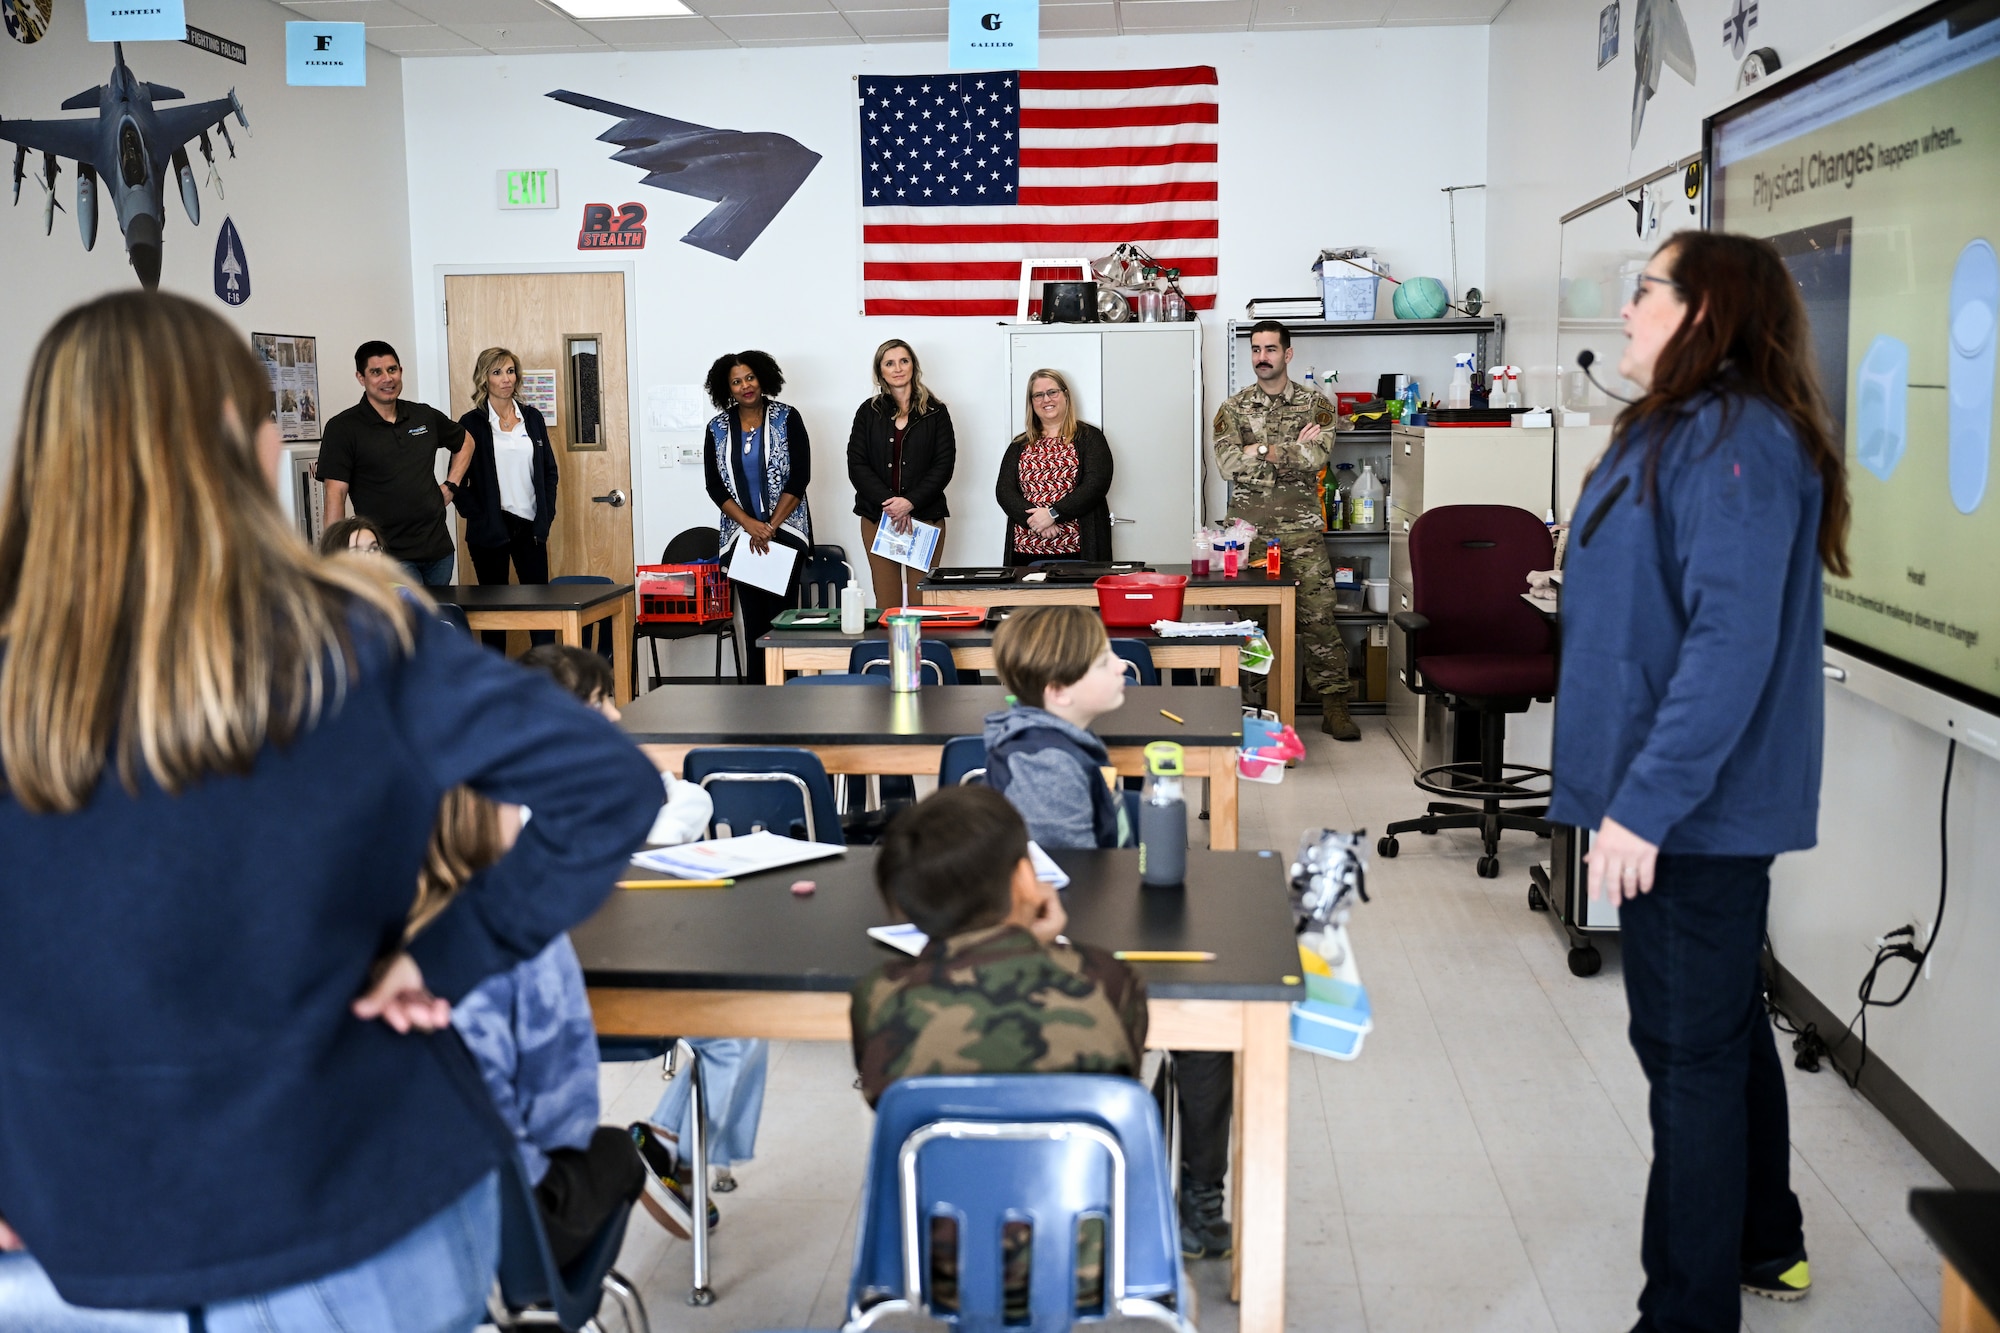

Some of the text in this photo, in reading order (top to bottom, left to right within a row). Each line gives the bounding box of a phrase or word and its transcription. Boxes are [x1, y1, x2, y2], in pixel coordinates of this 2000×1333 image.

[110, 8, 161, 16] EINSTEIN
[980, 13, 1003, 31] G
[190, 30, 220, 52] FIGHTING
[220, 41, 245, 61] FALCON
[313, 35, 333, 51] F
[1753, 156, 1805, 212] Physical
[1808, 142, 1875, 189] Changes
[1877, 138, 1920, 171] happen
[507, 171, 548, 205] EXIT
[584, 204, 647, 232] B-2
[583, 232, 642, 247] STEALTH
[227, 292, 240, 303] F-16
